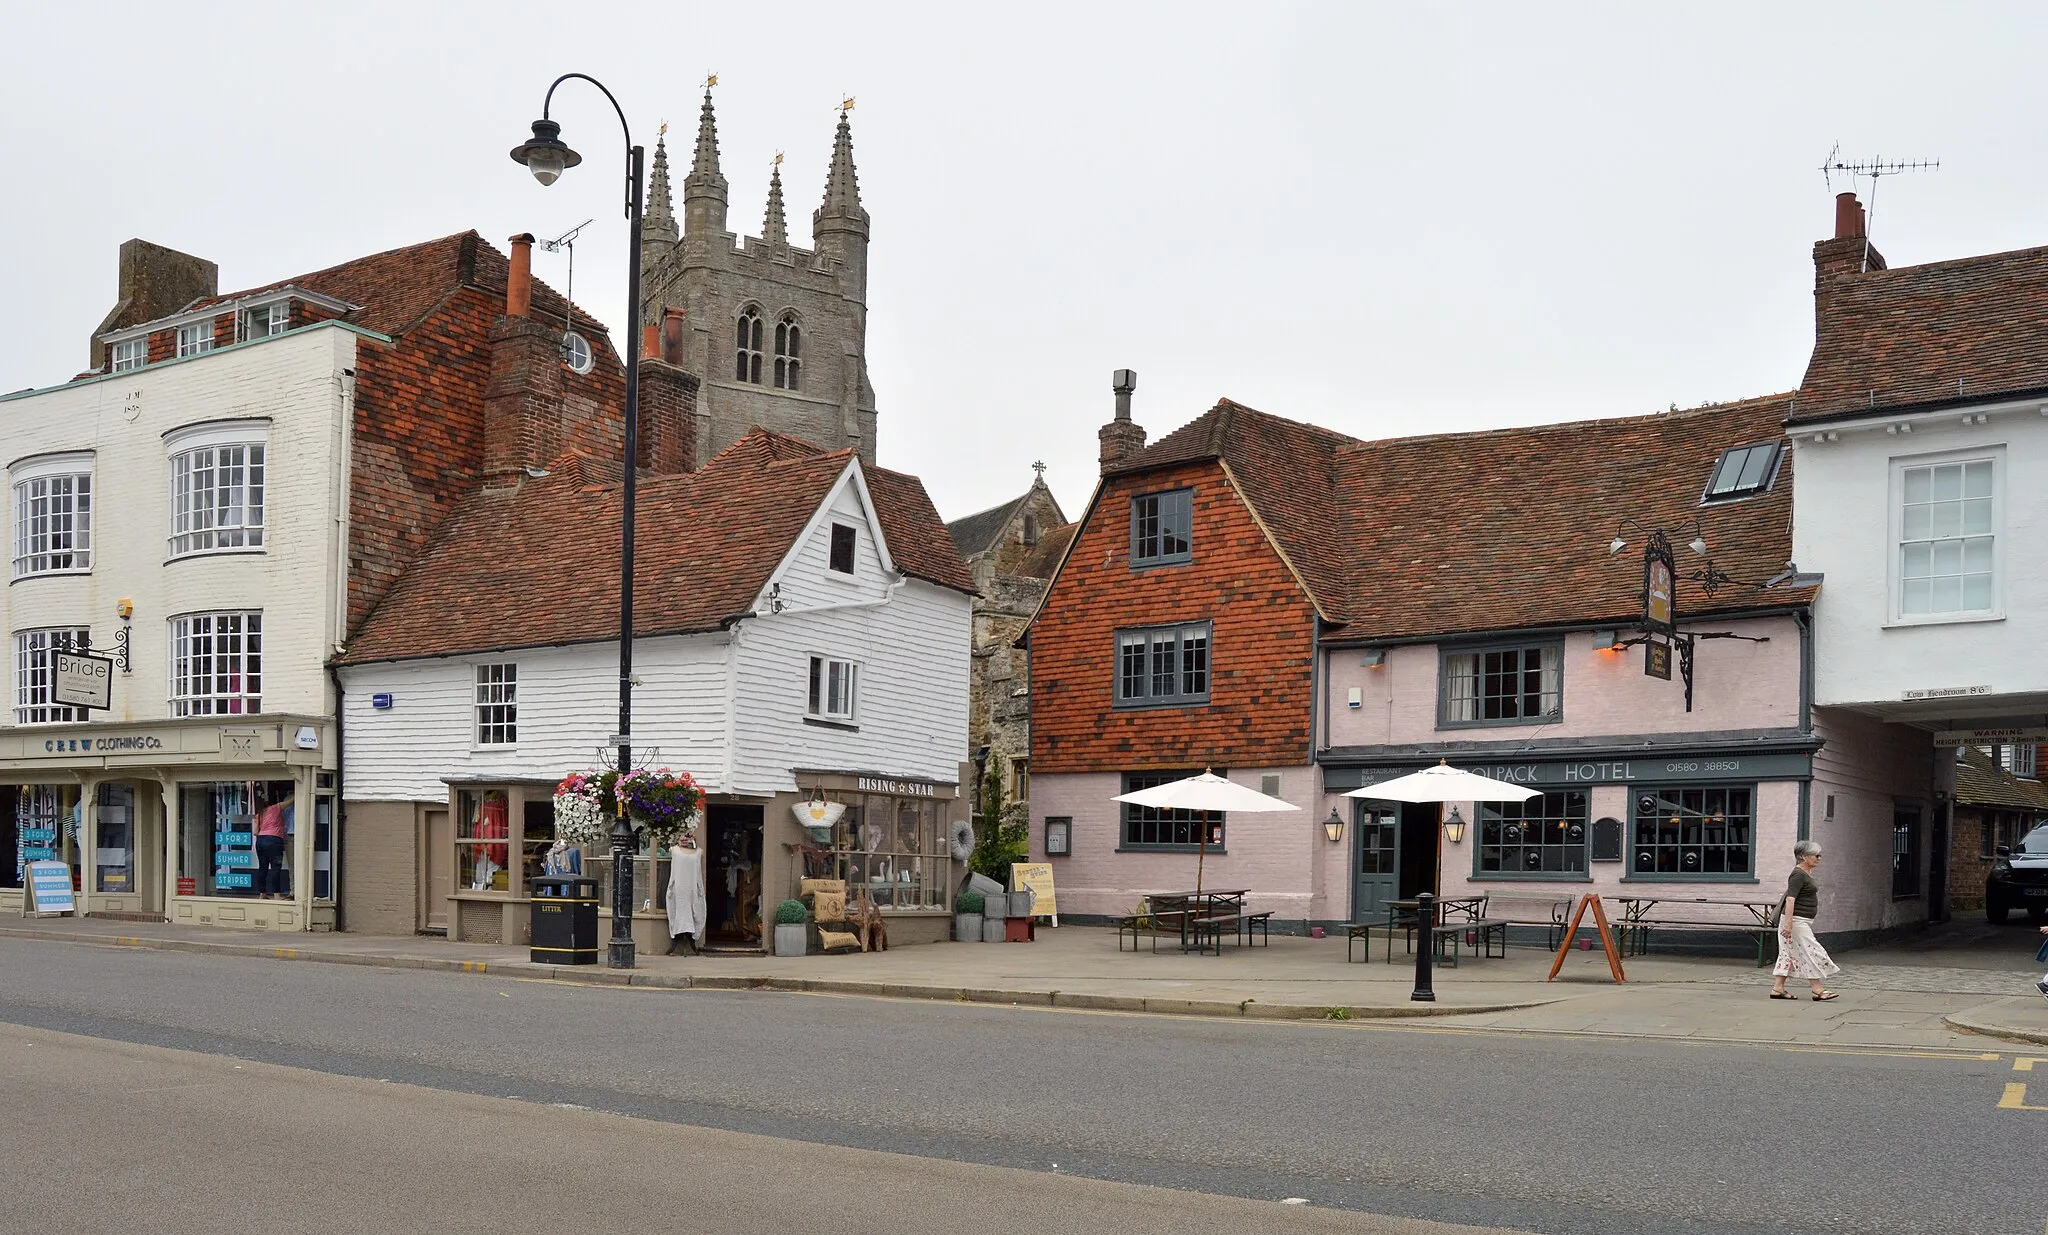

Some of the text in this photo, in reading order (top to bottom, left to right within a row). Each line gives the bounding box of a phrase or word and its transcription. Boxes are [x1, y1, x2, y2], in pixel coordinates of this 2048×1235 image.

[60, 657, 106, 678] Bride
[1906, 690, 1924, 699] Low
[1973, 728, 2024, 737] WARNING
[45, 739, 93, 752] CREW
[96, 737, 145, 751] CLOTHING
[1935, 738, 1961, 746] HEIGHT
[1963, 736, 2008, 745] RESTRICTION
[1361, 767, 1402, 775] RESTAURANT
[1666, 761, 1740, 772] 01580 388501
[1565, 762, 1636, 781] HOTEL
[858, 777, 934, 796] RISING STAR
[219, 834, 248, 843] 3 FOR 2
[25, 849, 51, 857] SUMMER
[217, 855, 249, 864] SUMMER
[218, 876, 249, 885] STRIPES
[541, 905, 562, 913] LITTER
